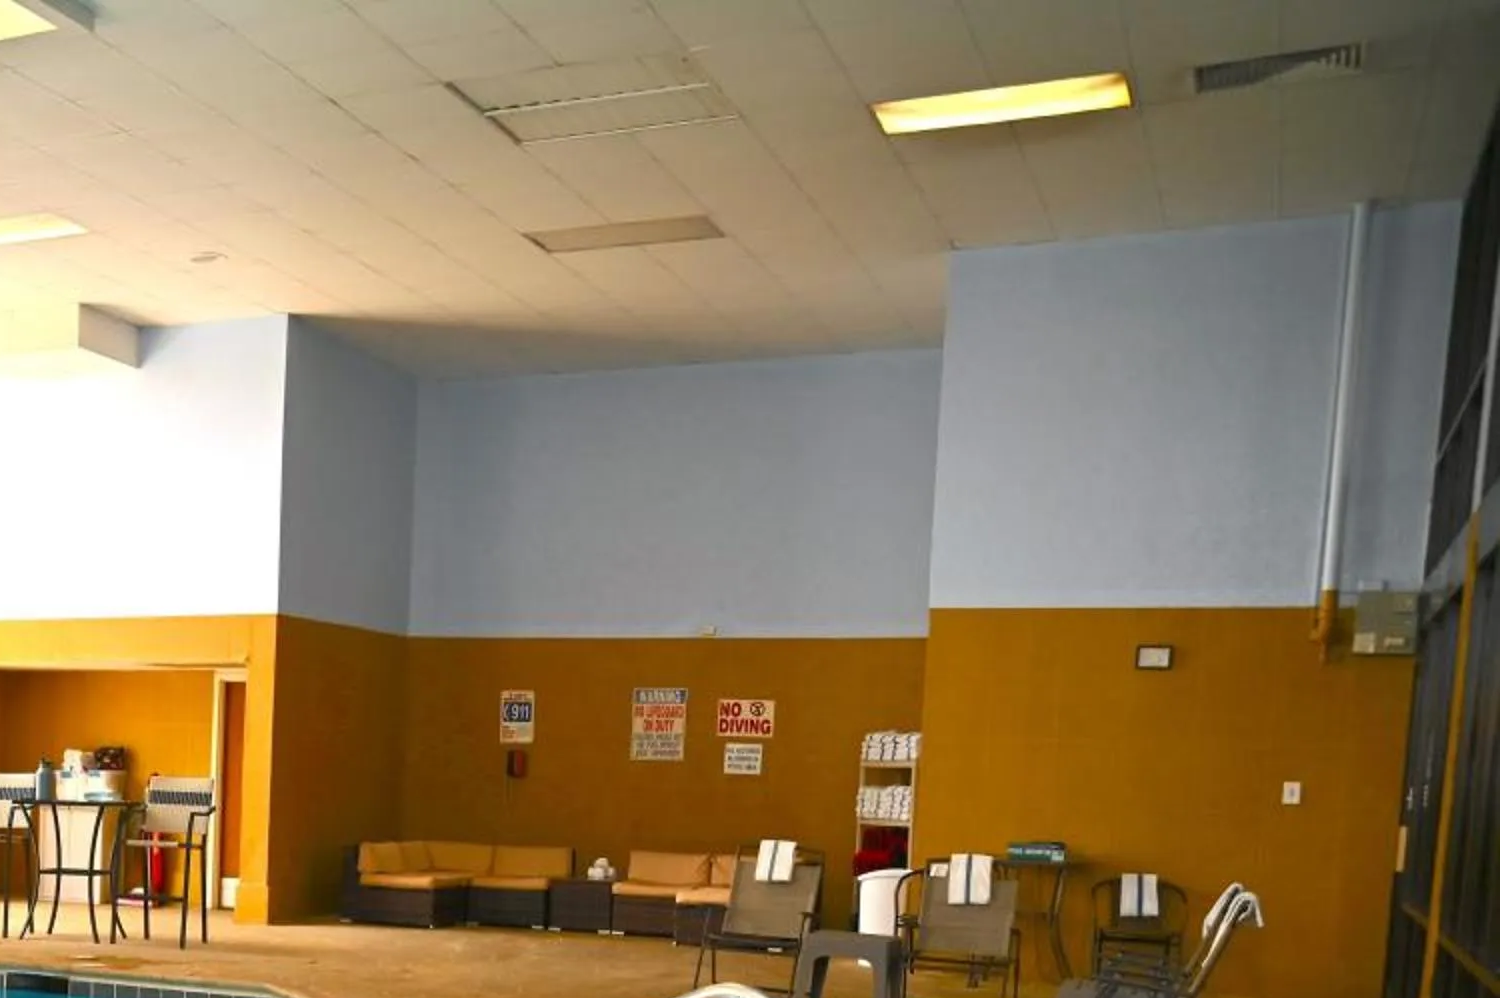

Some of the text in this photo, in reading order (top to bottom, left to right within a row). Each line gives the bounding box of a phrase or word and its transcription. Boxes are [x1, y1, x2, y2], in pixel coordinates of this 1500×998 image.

[511, 704, 529, 720] 911
[719, 702, 742, 717] NO
[719, 718, 771, 734] DIVING
